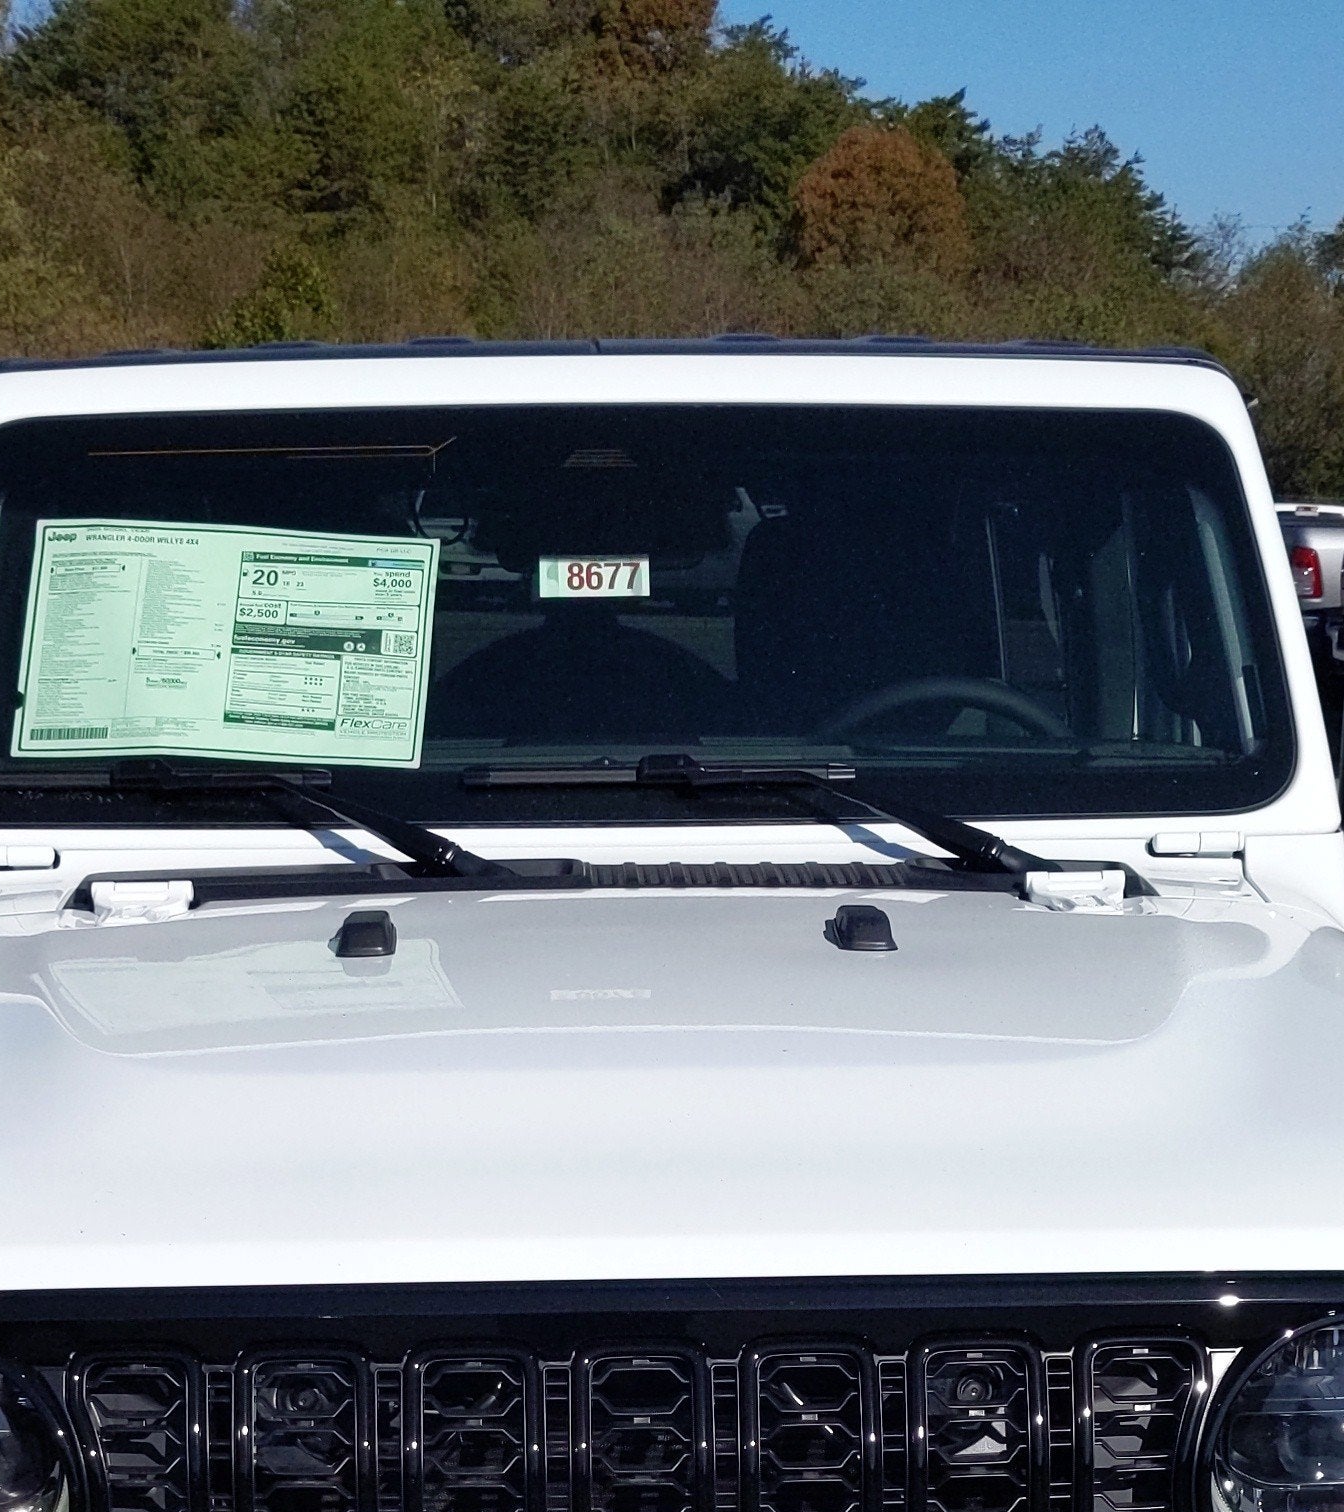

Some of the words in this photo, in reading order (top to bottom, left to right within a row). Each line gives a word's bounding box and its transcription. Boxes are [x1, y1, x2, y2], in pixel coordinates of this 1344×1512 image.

[48, 531, 77, 542] Jeep
[85, 534, 126, 543] WRANGLER
[127, 536, 155, 544] 4-DOOR
[157, 537, 184, 545] WILLYS
[252, 569, 278, 587] 20
[567, 562, 640, 590] 8677
[373, 577, 412, 588] $4,000
[238, 607, 279, 619] $2,500
[340, 718, 407, 729] FlexCare
